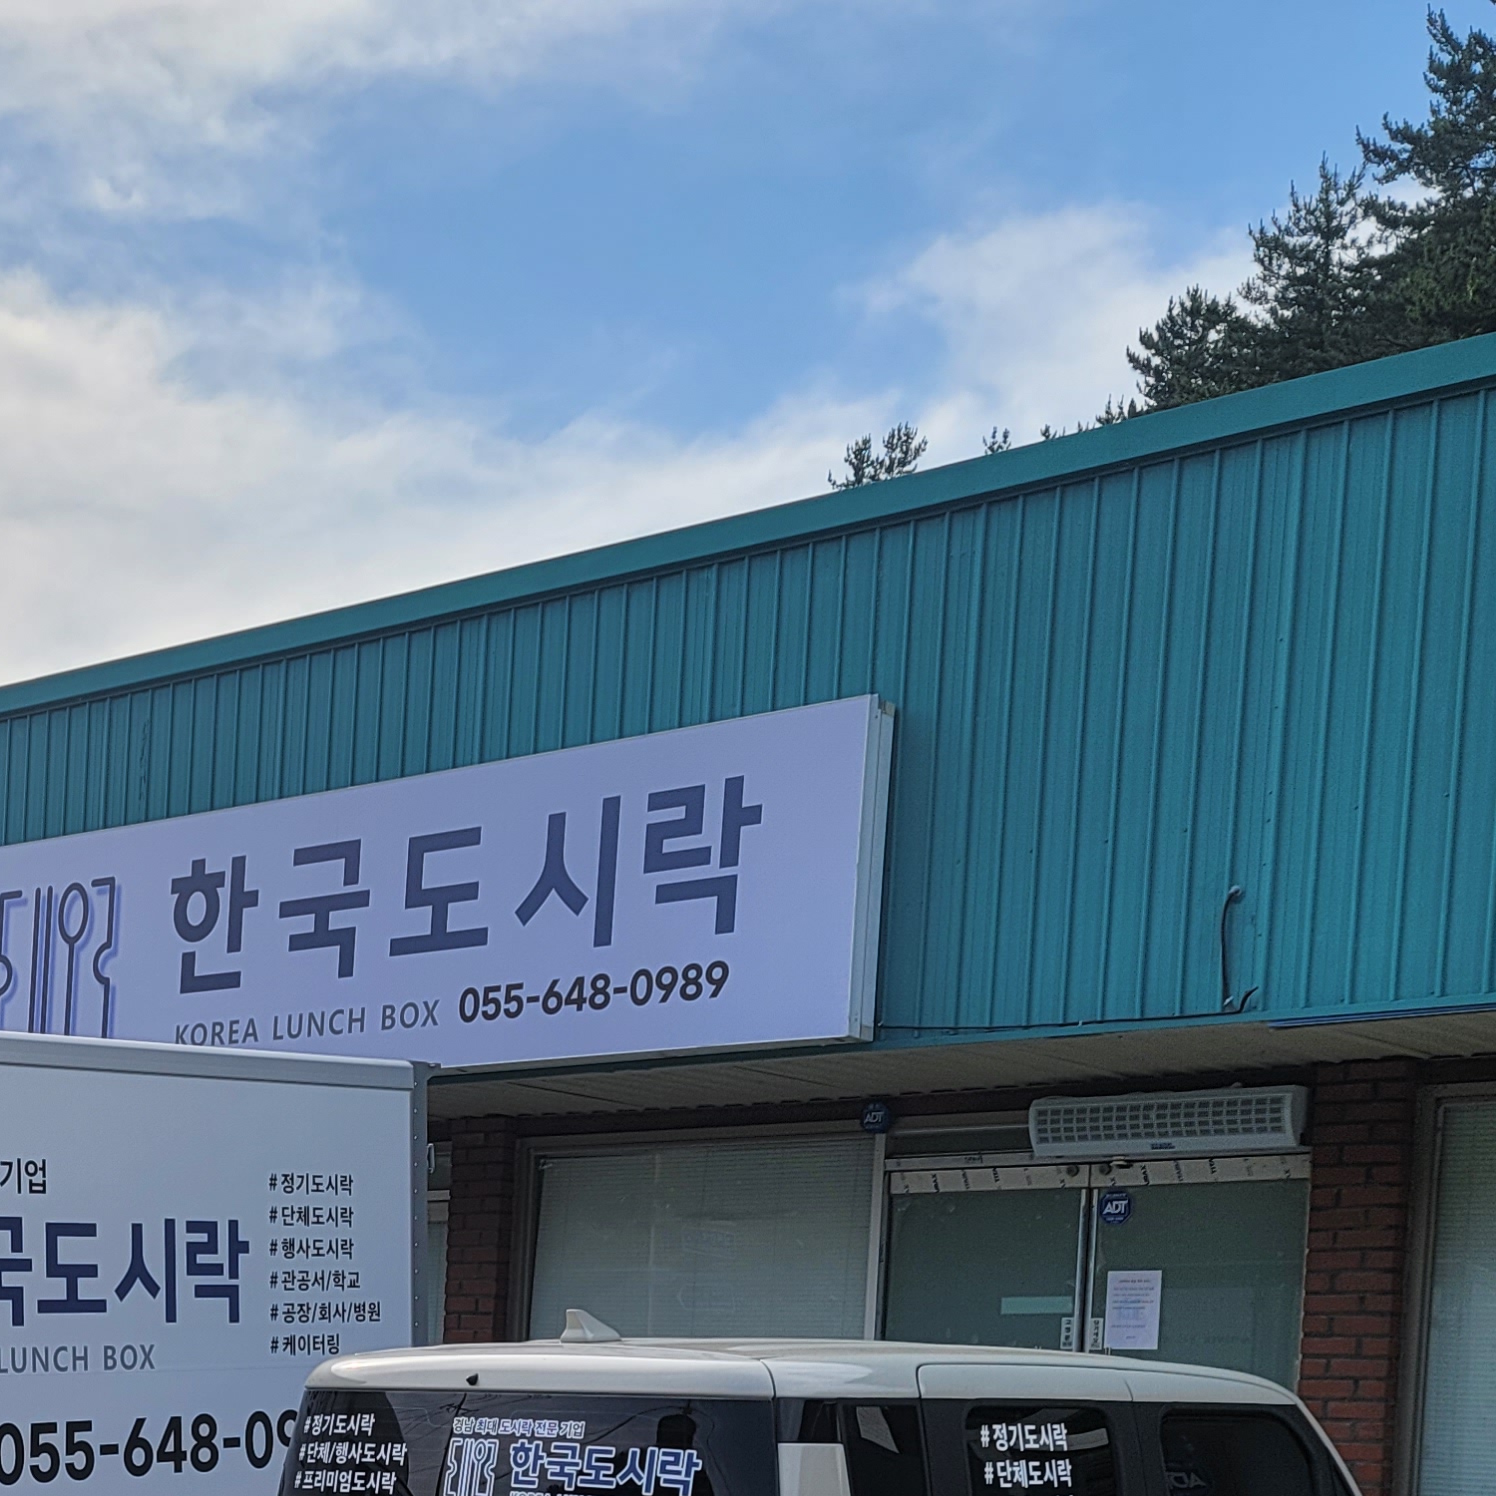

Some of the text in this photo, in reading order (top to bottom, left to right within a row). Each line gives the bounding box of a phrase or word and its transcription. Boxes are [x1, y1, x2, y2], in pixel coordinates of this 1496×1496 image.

[170, 775, 763, 994] 한국도시락
[174, 960, 730, 1047] KOREA LUNCH BOX 055-648-0989
[1102, 1200, 1129, 1215] ADT
[103, 1343, 157, 1371] BOX
[303, 1412, 376, 1436] #정기도시락
[453, 1418, 585, 1438] 경남 최대 도시락 전문 기업
